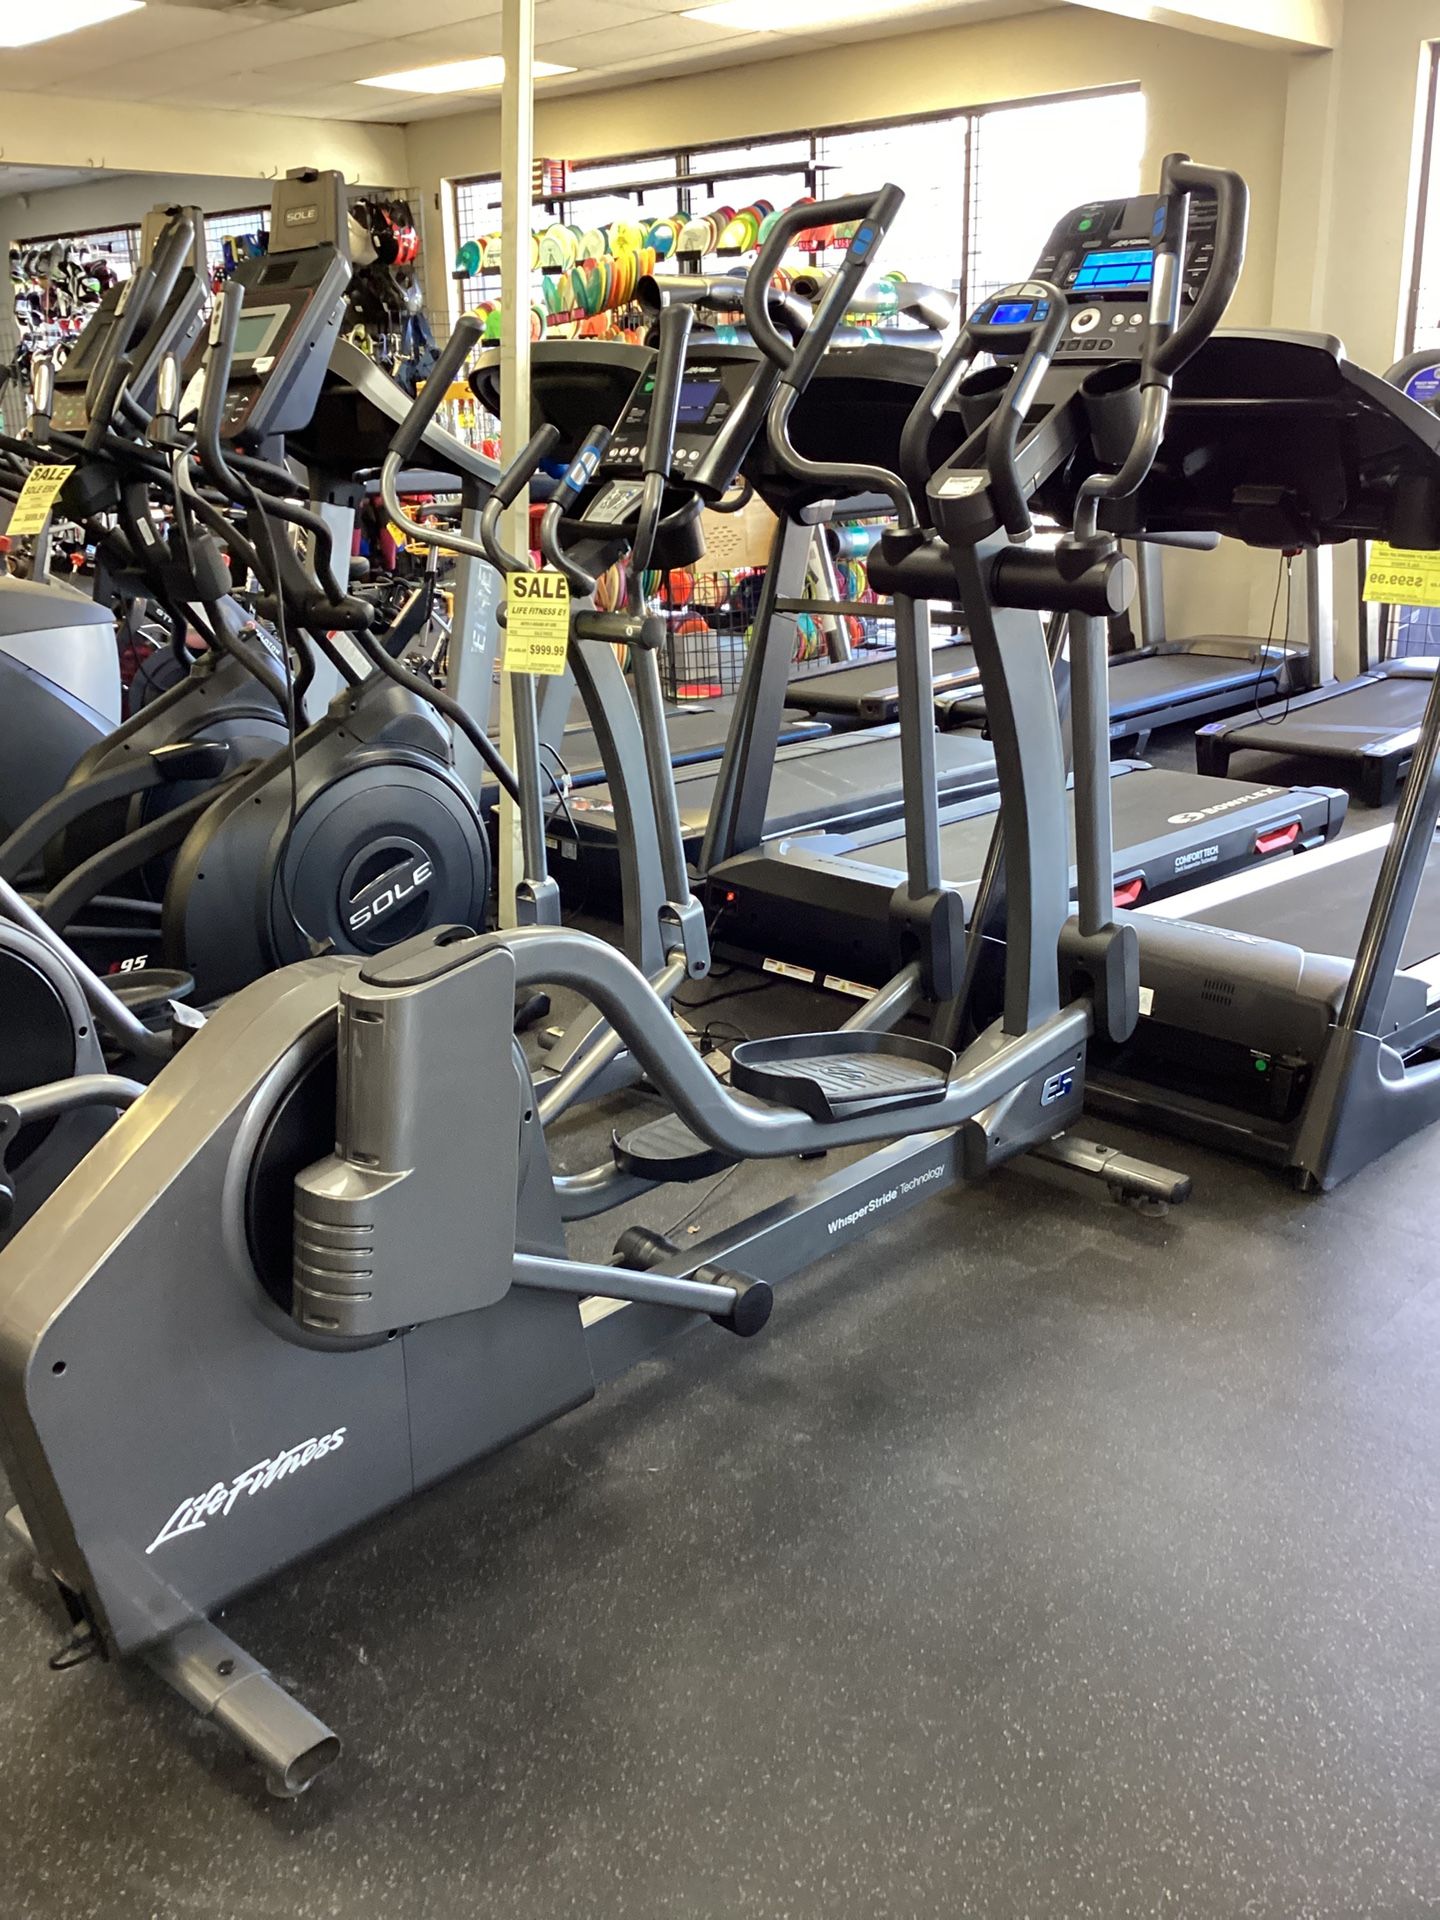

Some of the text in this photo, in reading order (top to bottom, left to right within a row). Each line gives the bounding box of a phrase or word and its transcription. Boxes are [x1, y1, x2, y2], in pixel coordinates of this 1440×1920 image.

[287, 209, 315, 221] SOLE
[31, 468, 70, 481] SALE
[513, 576, 567, 599] SALE
[512, 607, 528, 615] LIFE
[529, 607, 556, 616] FITNESS
[529, 644, 565, 657] $999.99
[349, 861, 432, 931] SOLE
[827, 1164, 945, 1234] WhisperStride Technology
